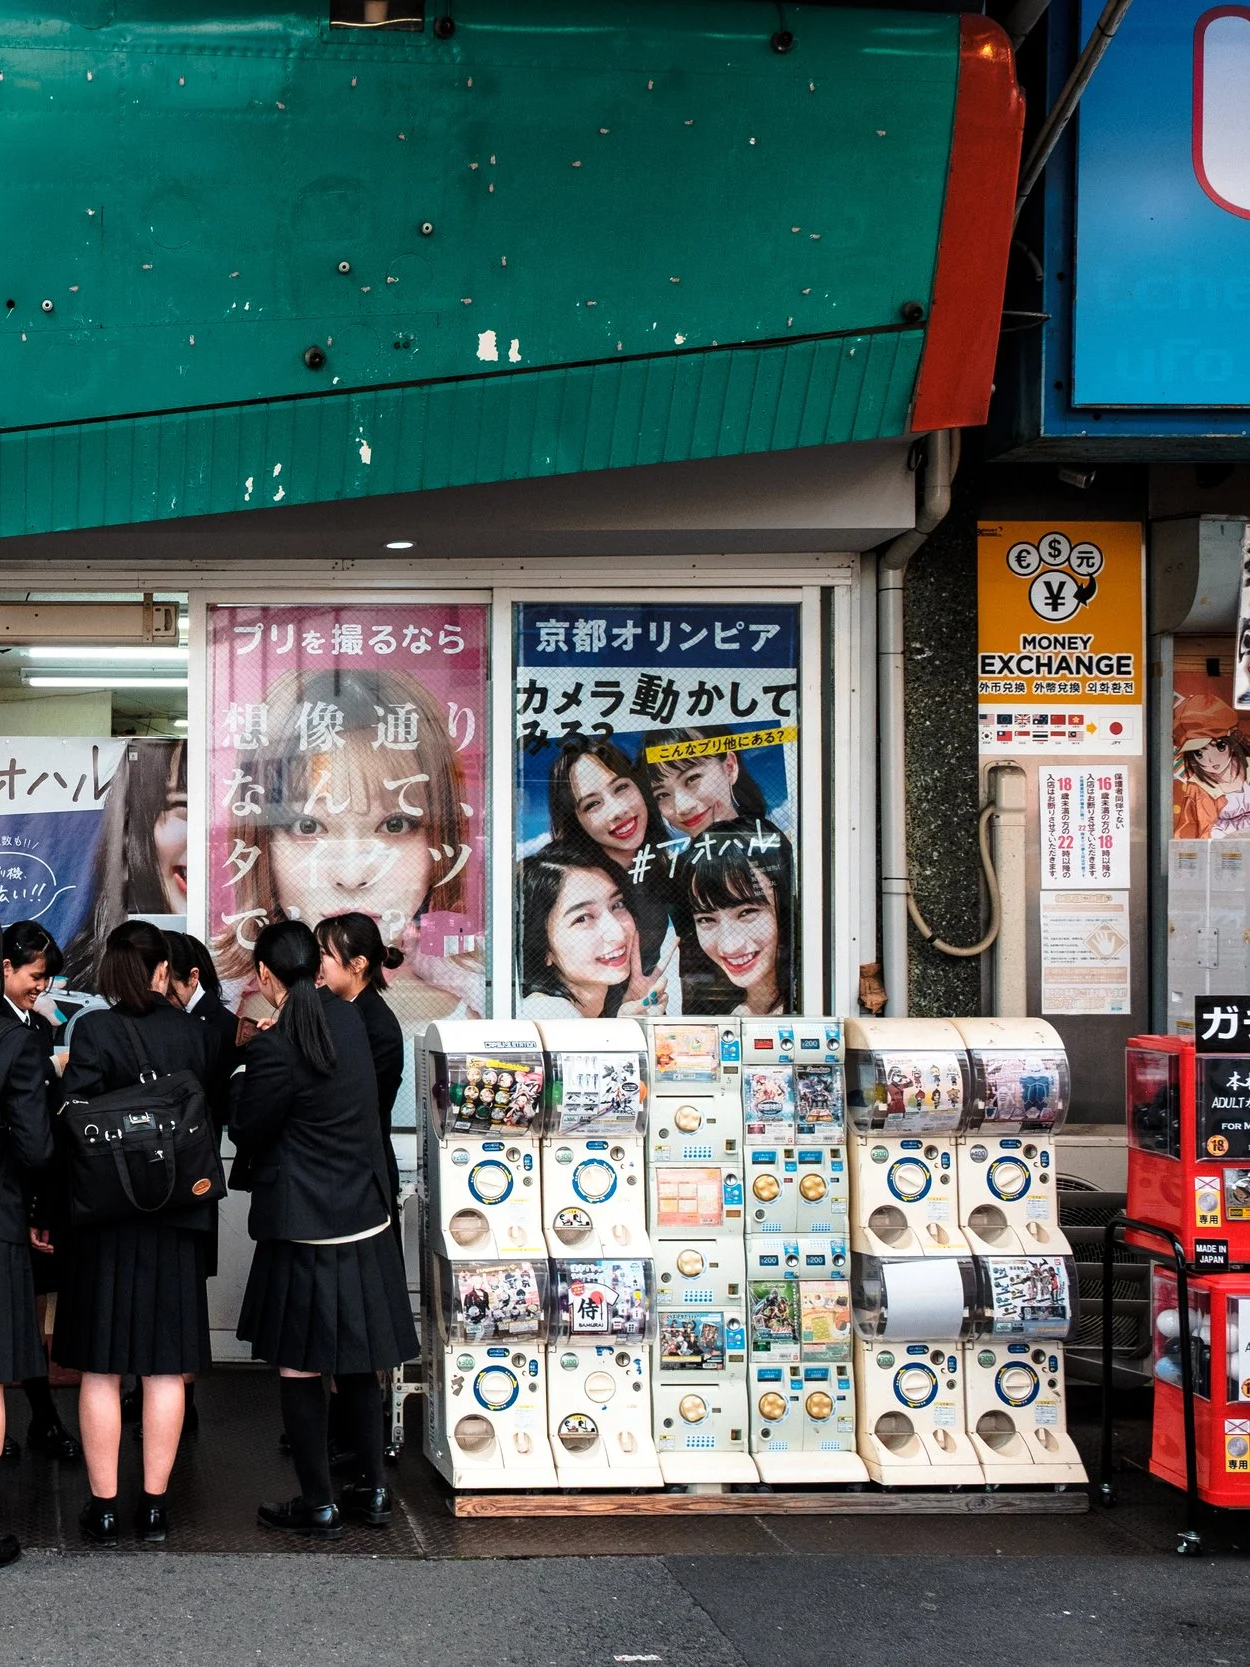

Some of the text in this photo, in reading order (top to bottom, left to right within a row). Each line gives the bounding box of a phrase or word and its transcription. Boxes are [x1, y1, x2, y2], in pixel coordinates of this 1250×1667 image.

[232, 622, 467, 657] プリを撮るなら
[534, 618, 781, 654] 京都オリンピア
[1021, 635, 1093, 651] MONEY
[979, 654, 1133, 677] EXCHANGE
[1086, 681, 1134, 694] 외화환전
[516, 671, 798, 726] カメラ動かして
[221, 700, 477, 753] 想像通り
[1201, 1005, 1250, 1041] ガ
[1221, 1122, 1242, 1130] FOR
[1210, 1139, 1224, 1153] 18
[1198, 1214, 1219, 1225] 専用
[1195, 1244, 1227, 1253] MADE IN
[1199, 1255, 1225, 1264] JAPAN
[577, 1297, 600, 1321] 侍
[1227, 1459, 1248, 1470] 専用
